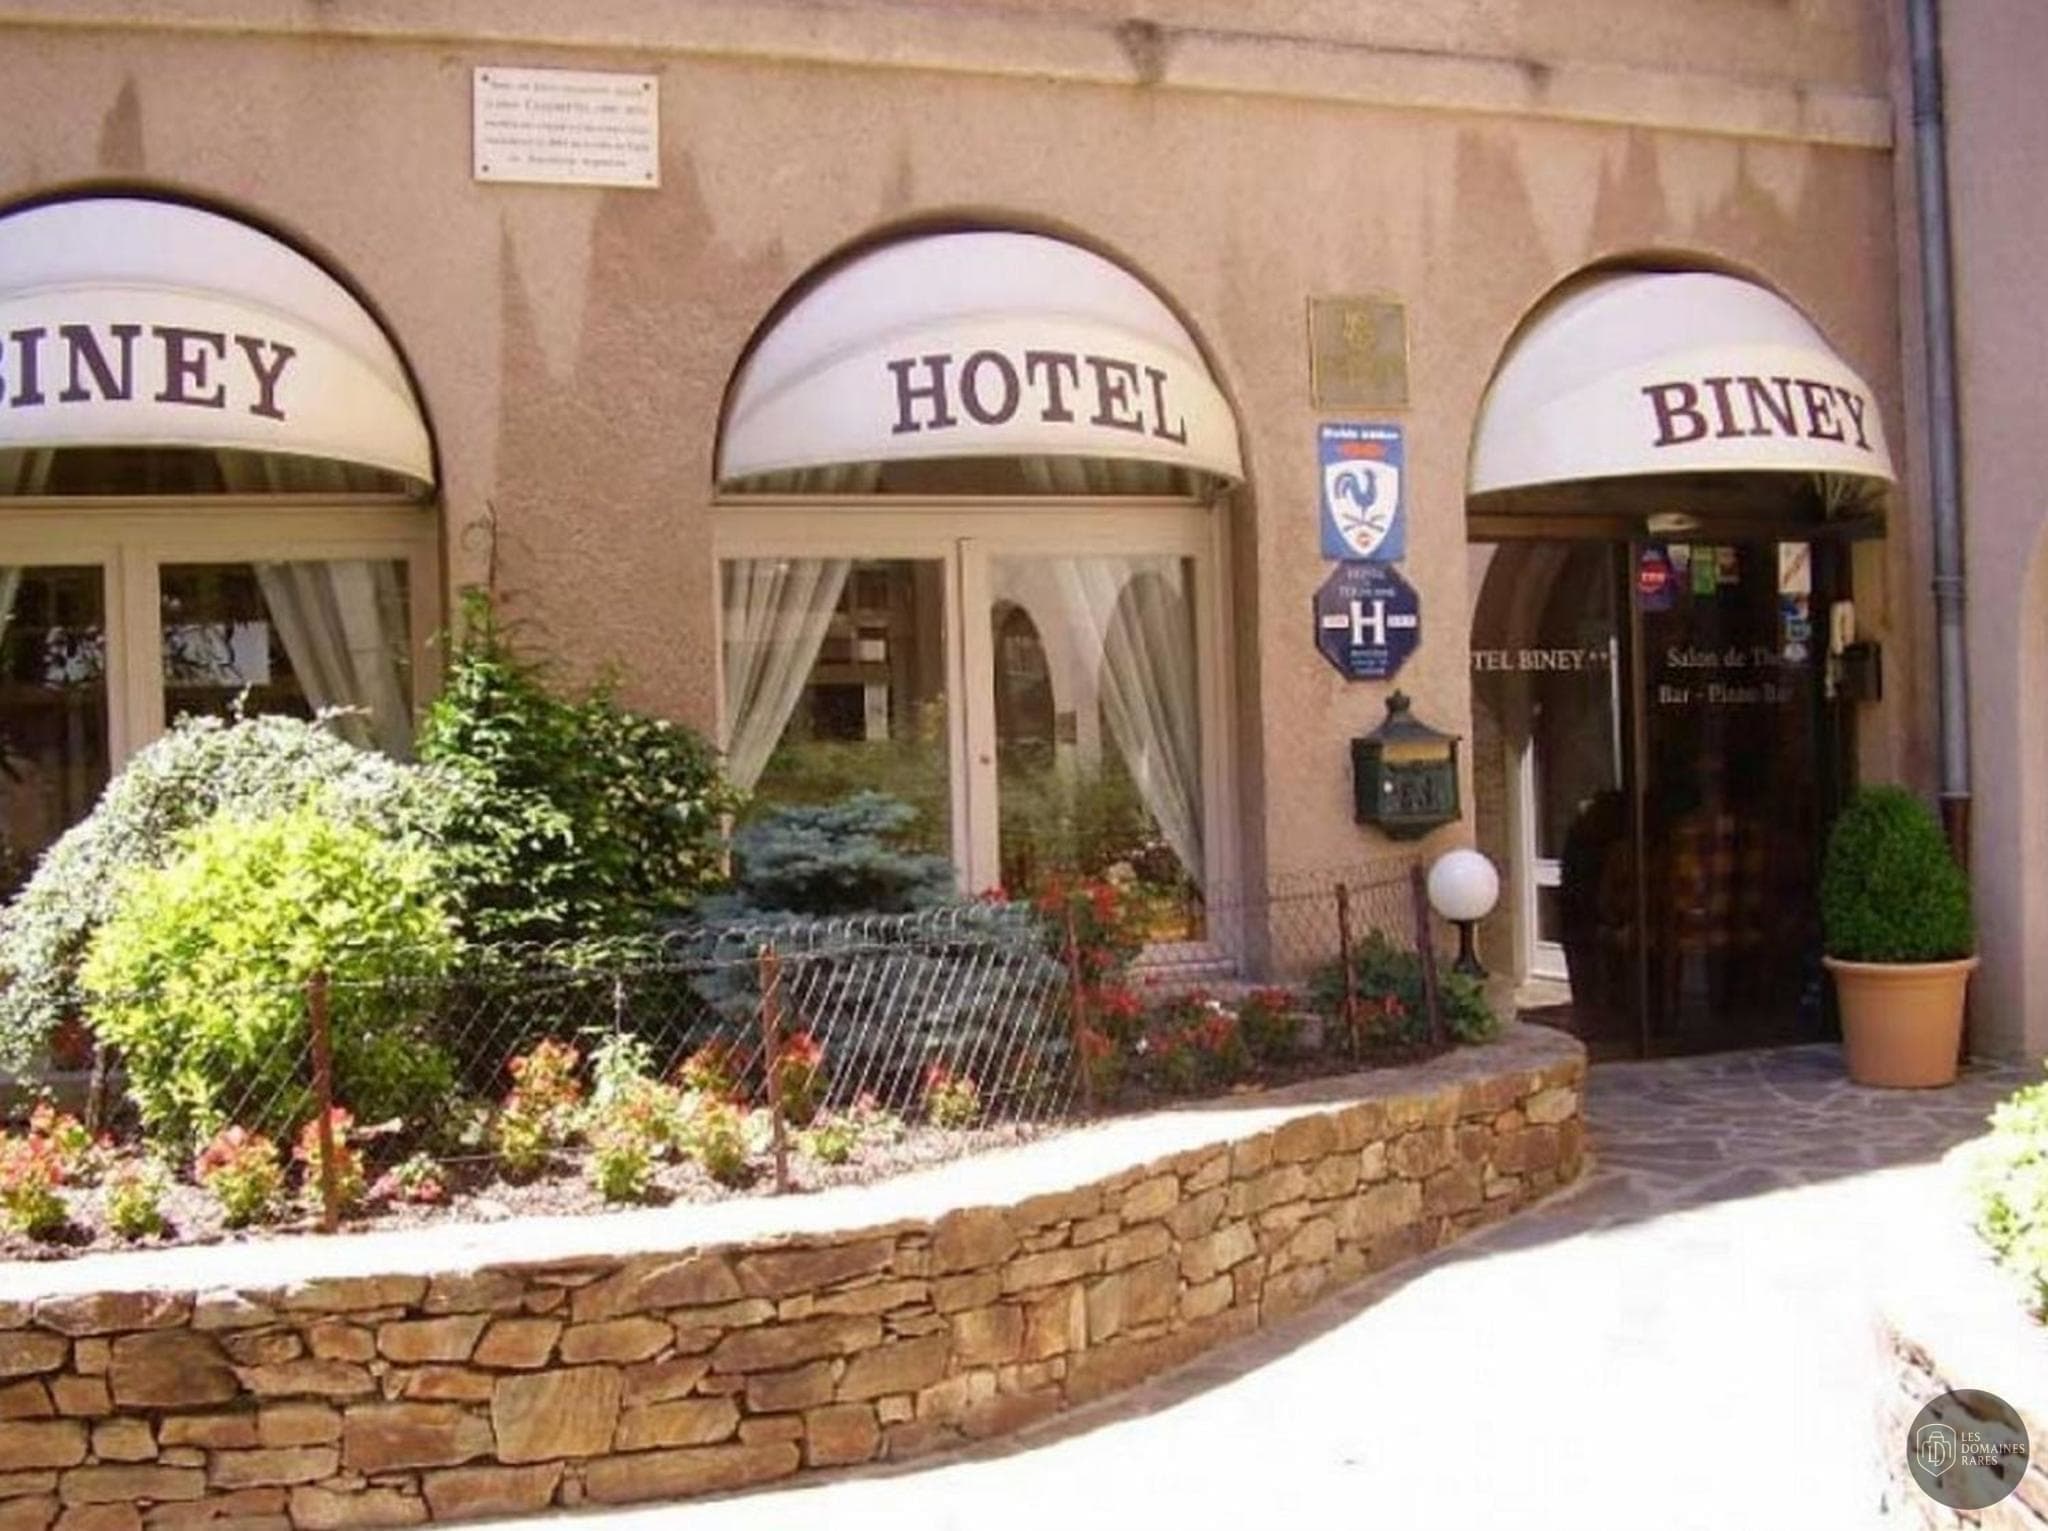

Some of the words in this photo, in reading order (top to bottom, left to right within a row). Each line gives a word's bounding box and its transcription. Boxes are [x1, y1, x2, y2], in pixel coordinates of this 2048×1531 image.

[0, 324, 296, 421] INEY
[887, 350, 1187, 445] HOTEL
[1641, 376, 1873, 452] BINEY
[1350, 600, 1386, 645] H
[1518, 650, 1585, 671] BINEY
